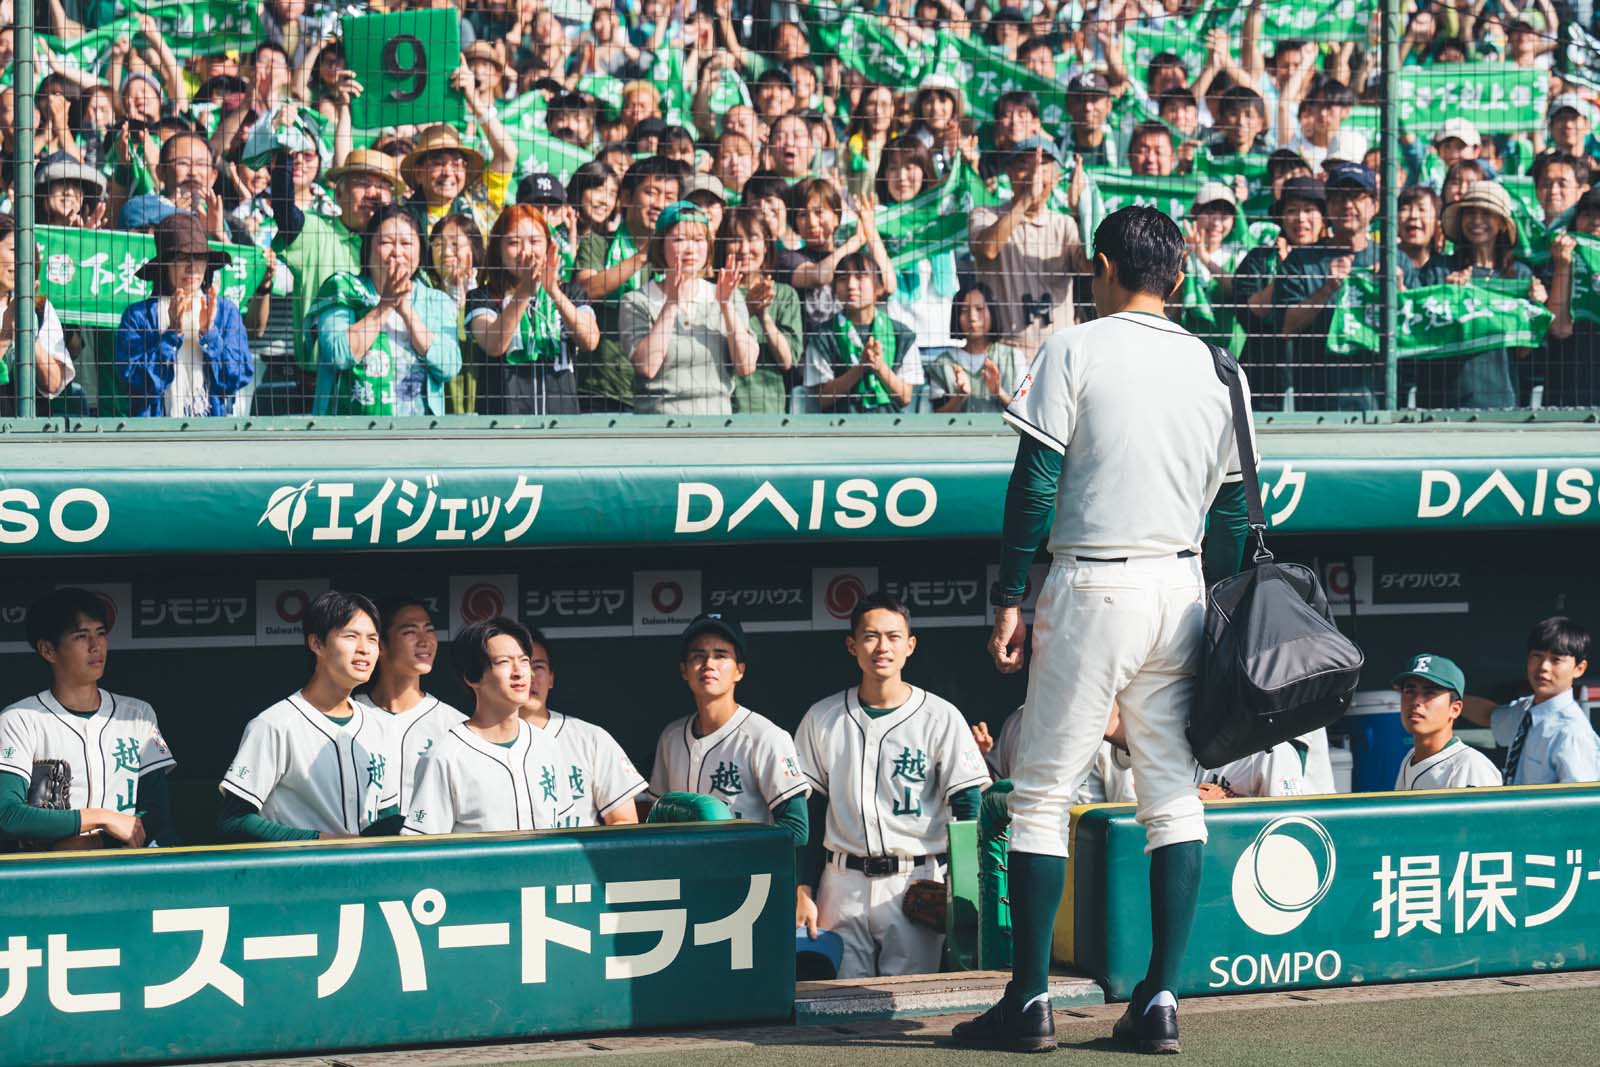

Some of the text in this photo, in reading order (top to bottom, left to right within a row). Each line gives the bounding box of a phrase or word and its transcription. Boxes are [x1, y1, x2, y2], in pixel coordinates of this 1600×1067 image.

[381, 34, 428, 102] 9
[312, 474, 544, 543] エイジェック
[675, 477, 938, 533] DAISO
[1417, 467, 1600, 518] DAIS
[526, 589, 625, 616] シモジマ
[709, 588, 804, 606] ダイワハウス
[885, 580, 979, 606] シモジマ
[1379, 571, 1462, 589] ダイワハウス
[140, 598, 248, 626] シモジマ
[1413, 656, 1431, 673] E
[112, 737, 141, 812] 越山
[890, 746, 927, 817] 越山
[1372, 849, 1600, 939] 損保ジ
[144, 873, 772, 1008] スーパードライ
[1209, 949, 1342, 988] SOMPO
